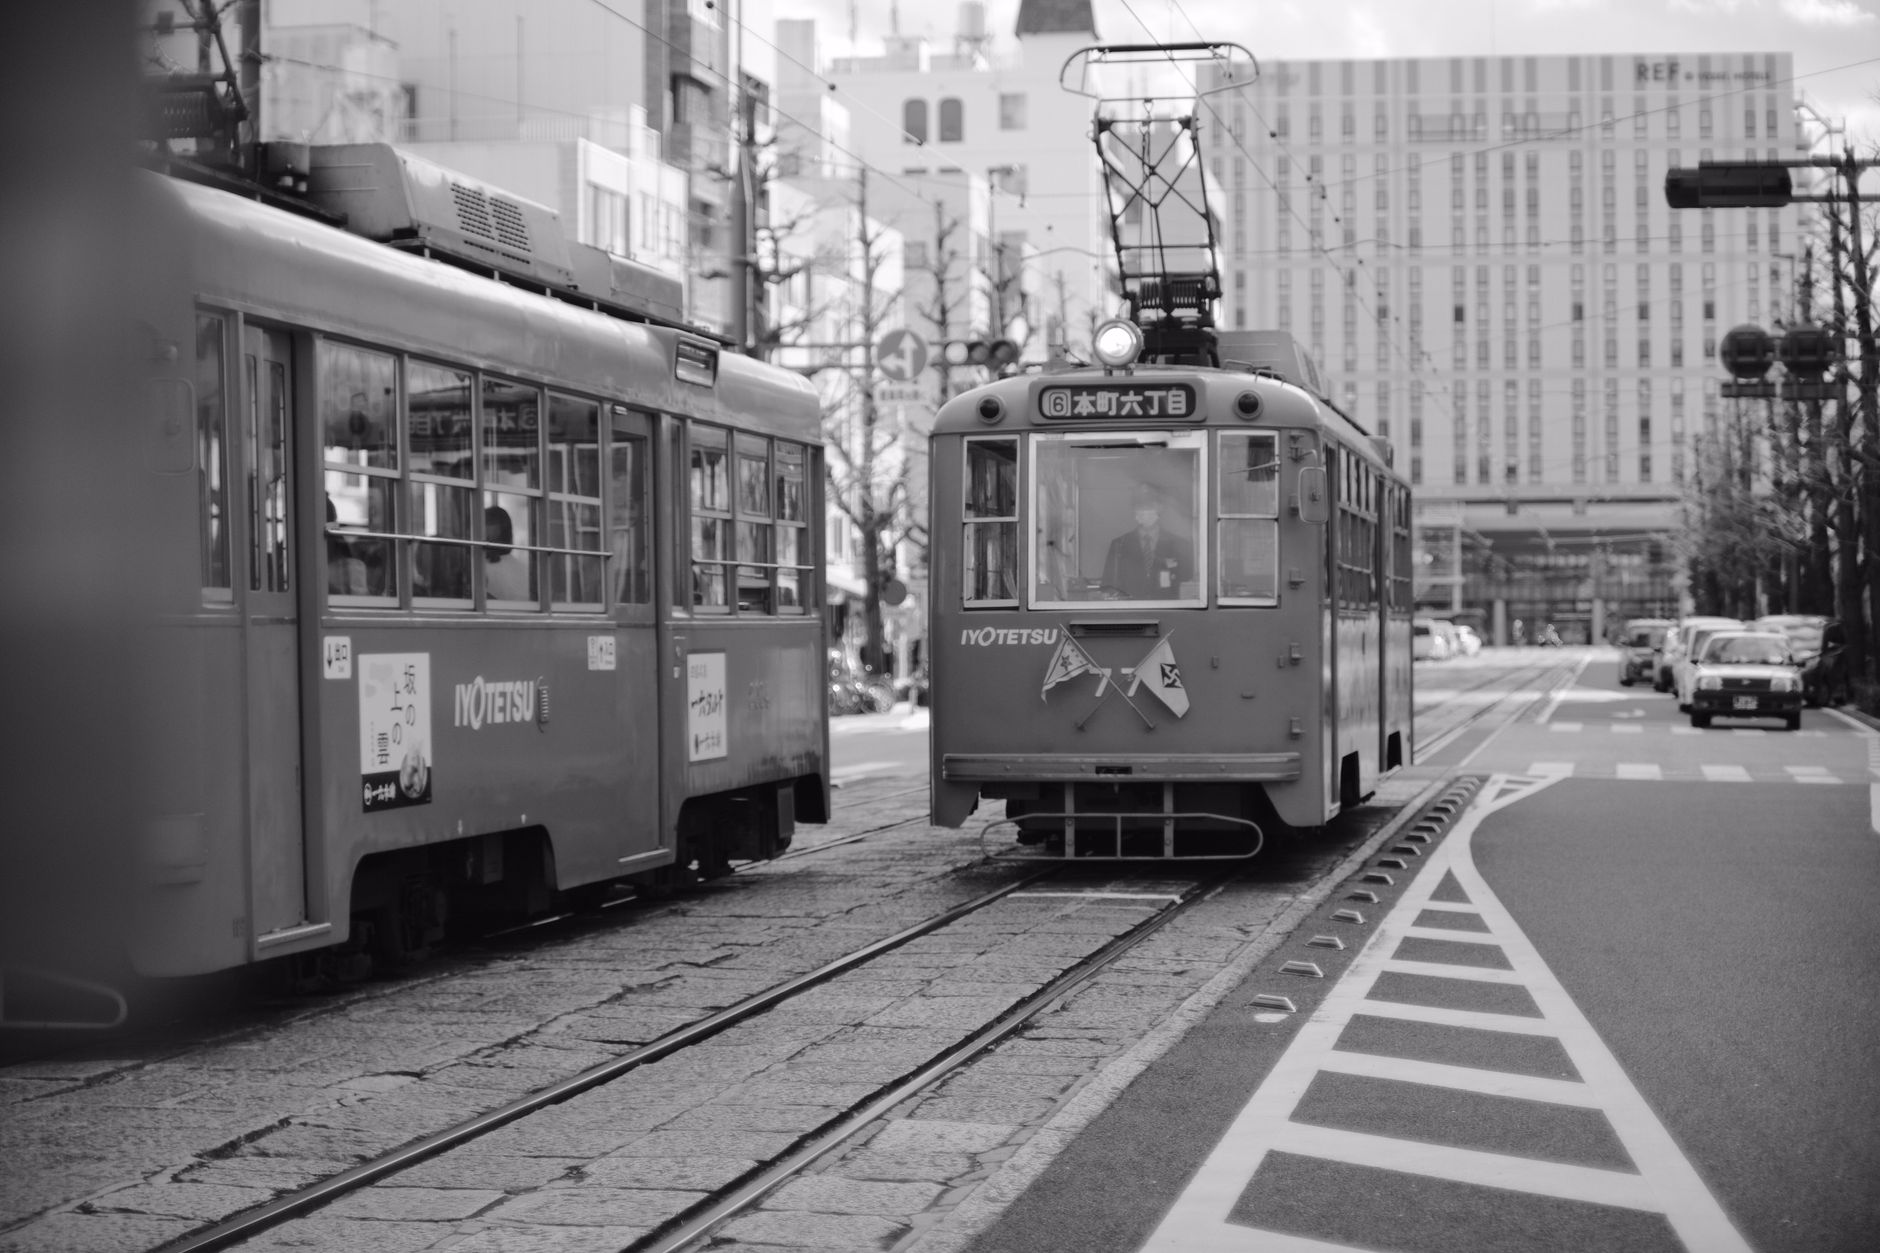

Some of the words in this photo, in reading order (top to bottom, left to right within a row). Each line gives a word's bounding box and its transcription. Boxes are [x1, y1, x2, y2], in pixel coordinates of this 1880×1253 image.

[1636, 62, 1679, 81] REF
[1051, 394, 1066, 415] 6
[1073, 389, 1187, 417] 本町六丁目
[960, 626, 1058, 647] IYOTETSU
[454, 675, 535, 730] IYOTETSU
